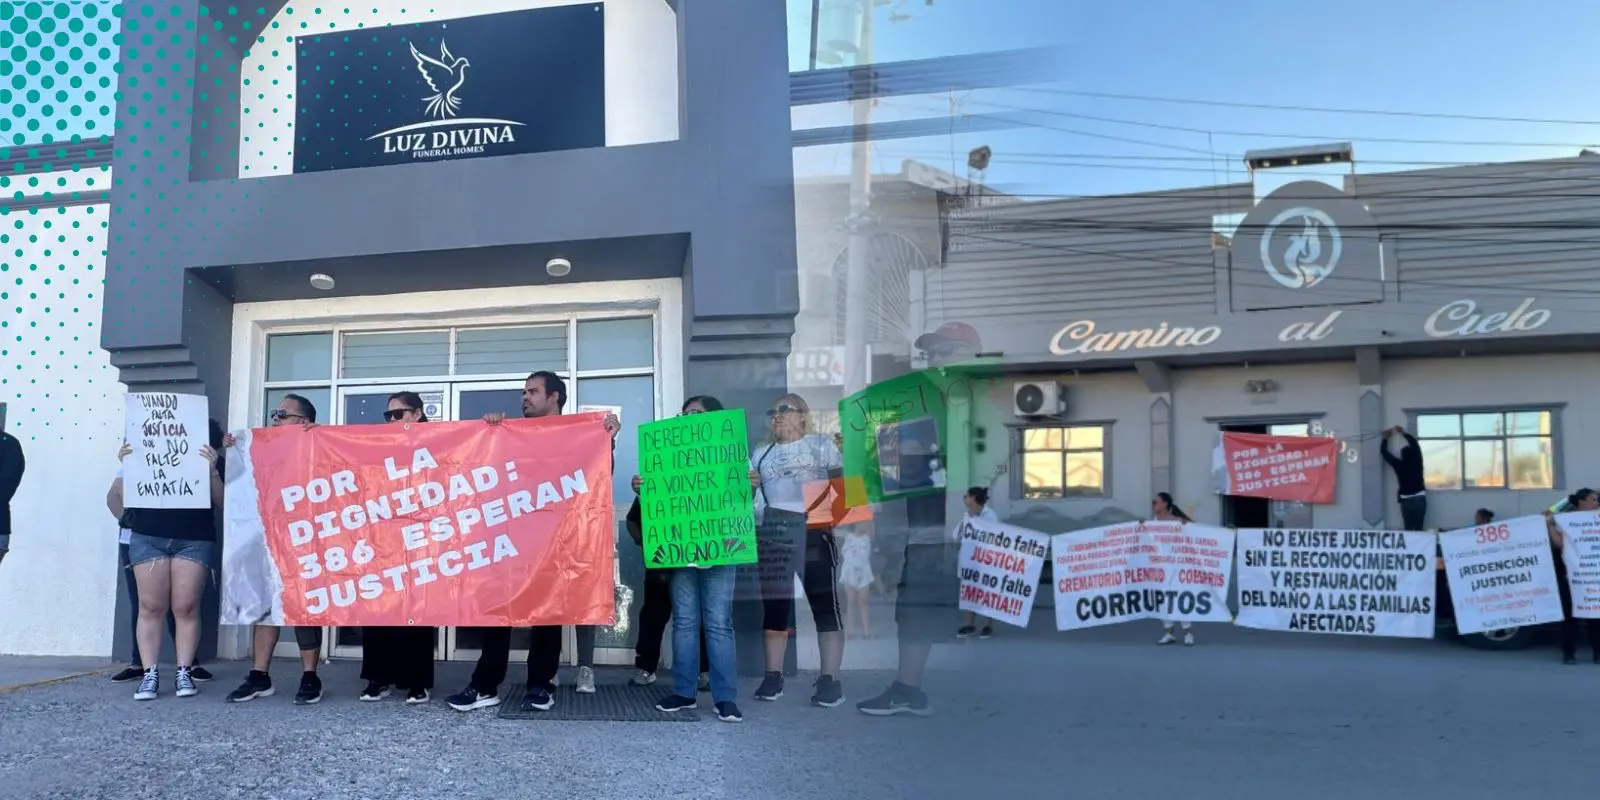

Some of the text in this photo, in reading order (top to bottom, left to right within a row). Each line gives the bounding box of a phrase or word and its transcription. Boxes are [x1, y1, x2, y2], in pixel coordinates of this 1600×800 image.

[384, 125, 515, 153] LUZ DIVINA
[413, 145, 484, 159] FUNERAL HOMES
[1049, 297, 1551, 356] Camino al Cielo
[151, 409, 175, 420] FALTA
[142, 418, 188, 437] JUSTICIA
[644, 418, 734, 452] DERECHO A
[166, 439, 188, 455] NO
[644, 443, 747, 473] LA IDENTIDAD
[1233, 443, 1283, 460] POR LA
[146, 453, 180, 467] FALTE
[1236, 456, 1329, 481] 386 ESPERAN
[153, 469, 166, 480] LA
[280, 447, 438, 512] POR LA
[646, 467, 740, 495] A VOLVER A
[1237, 472, 1306, 493] JUSTICIA
[287, 460, 518, 547] DIGNIDAD:
[647, 499, 665, 520] LA
[739, 490, 748, 509] Y
[298, 468, 590, 580] 386 ESPERAN
[648, 515, 753, 544] A UN ENTIERRO
[1475, 523, 1510, 544] 386
[1014, 535, 1045, 558] falta
[1263, 530, 1406, 549] NO EXISTE JUSTICIA
[971, 545, 1025, 574] JUSTICIA
[1245, 550, 1267, 567] SIN
[1271, 551, 1287, 567] EL
[1290, 552, 1426, 571] RECONOCIMIENTO
[1459, 554, 1539, 579] ¡REDENCIÓN!
[304, 533, 520, 615] JUSTICIA
[982, 572, 998, 588] no
[1001, 574, 1032, 597] falte
[1058, 570, 1122, 593] CREMATORIO
[1270, 571, 1397, 591] Y RESTAURACIÓN
[1471, 571, 1532, 592] ¡JUSTICIA!
[1076, 590, 1212, 622] CORRUPTOS
[1242, 588, 1431, 614] DEL DAÑO A LAS FAMILIAS
[1289, 613, 1376, 633] AFECTADAS
